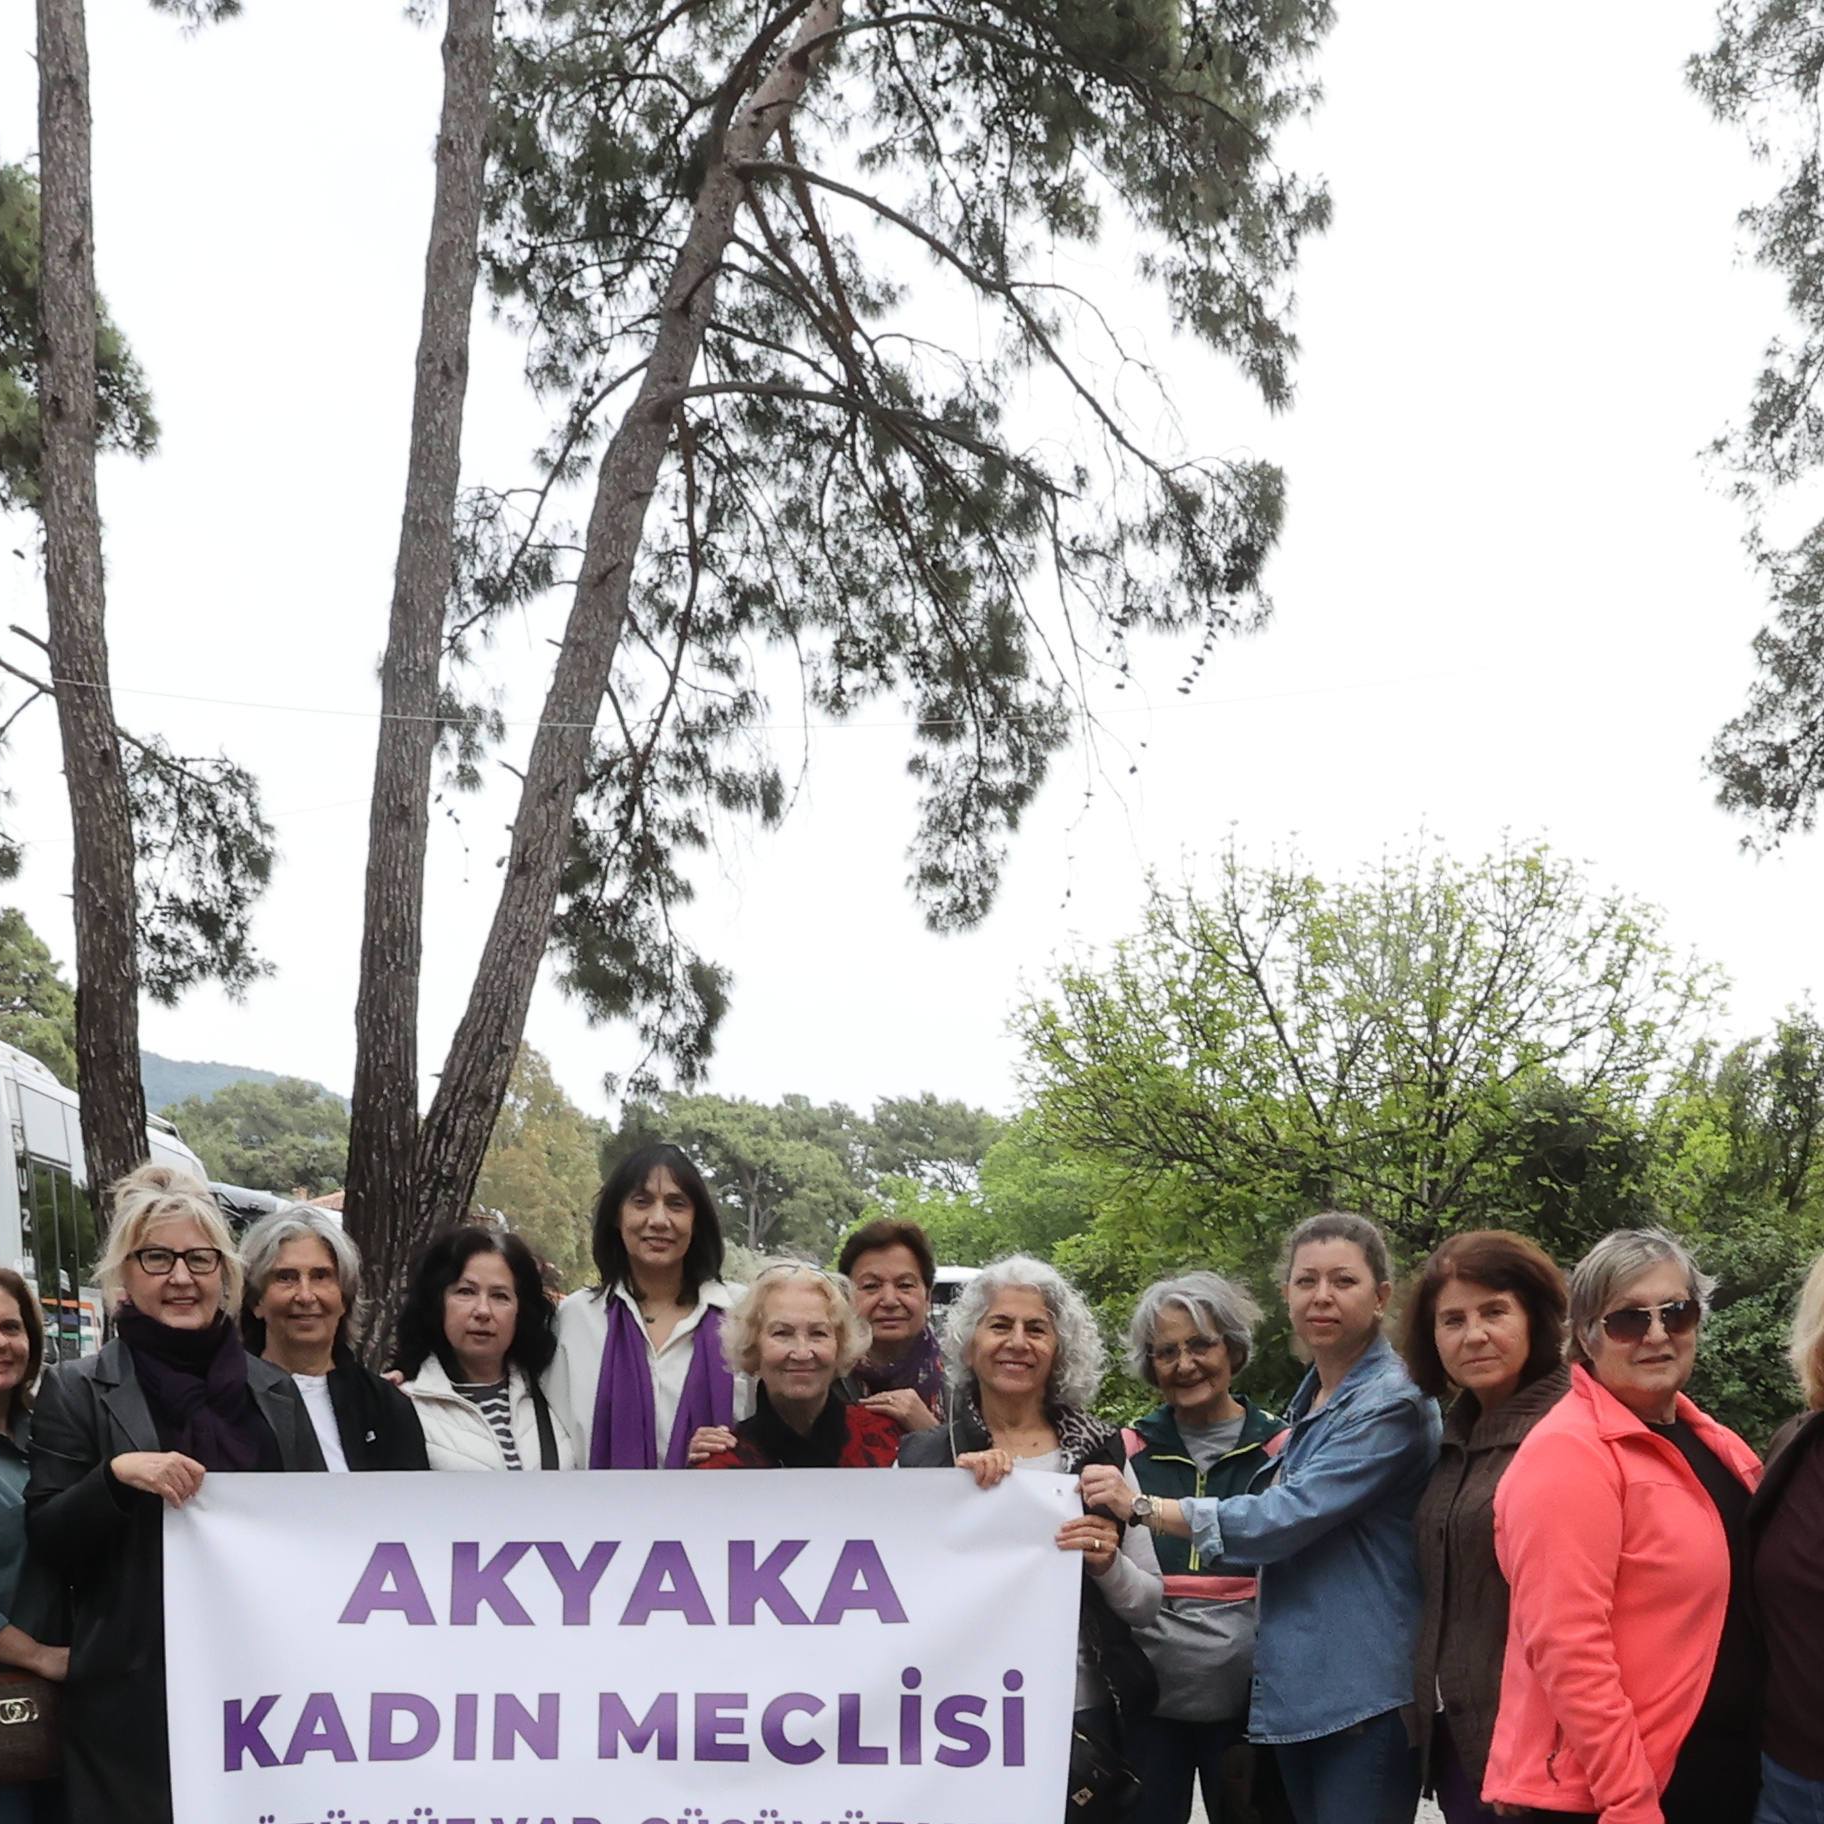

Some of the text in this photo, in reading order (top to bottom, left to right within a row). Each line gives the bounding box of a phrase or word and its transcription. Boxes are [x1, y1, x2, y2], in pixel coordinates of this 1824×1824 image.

[338, 1539, 909, 1626] AKYAKA
[223, 1666, 1026, 1773] KADIN MECLİSİ
